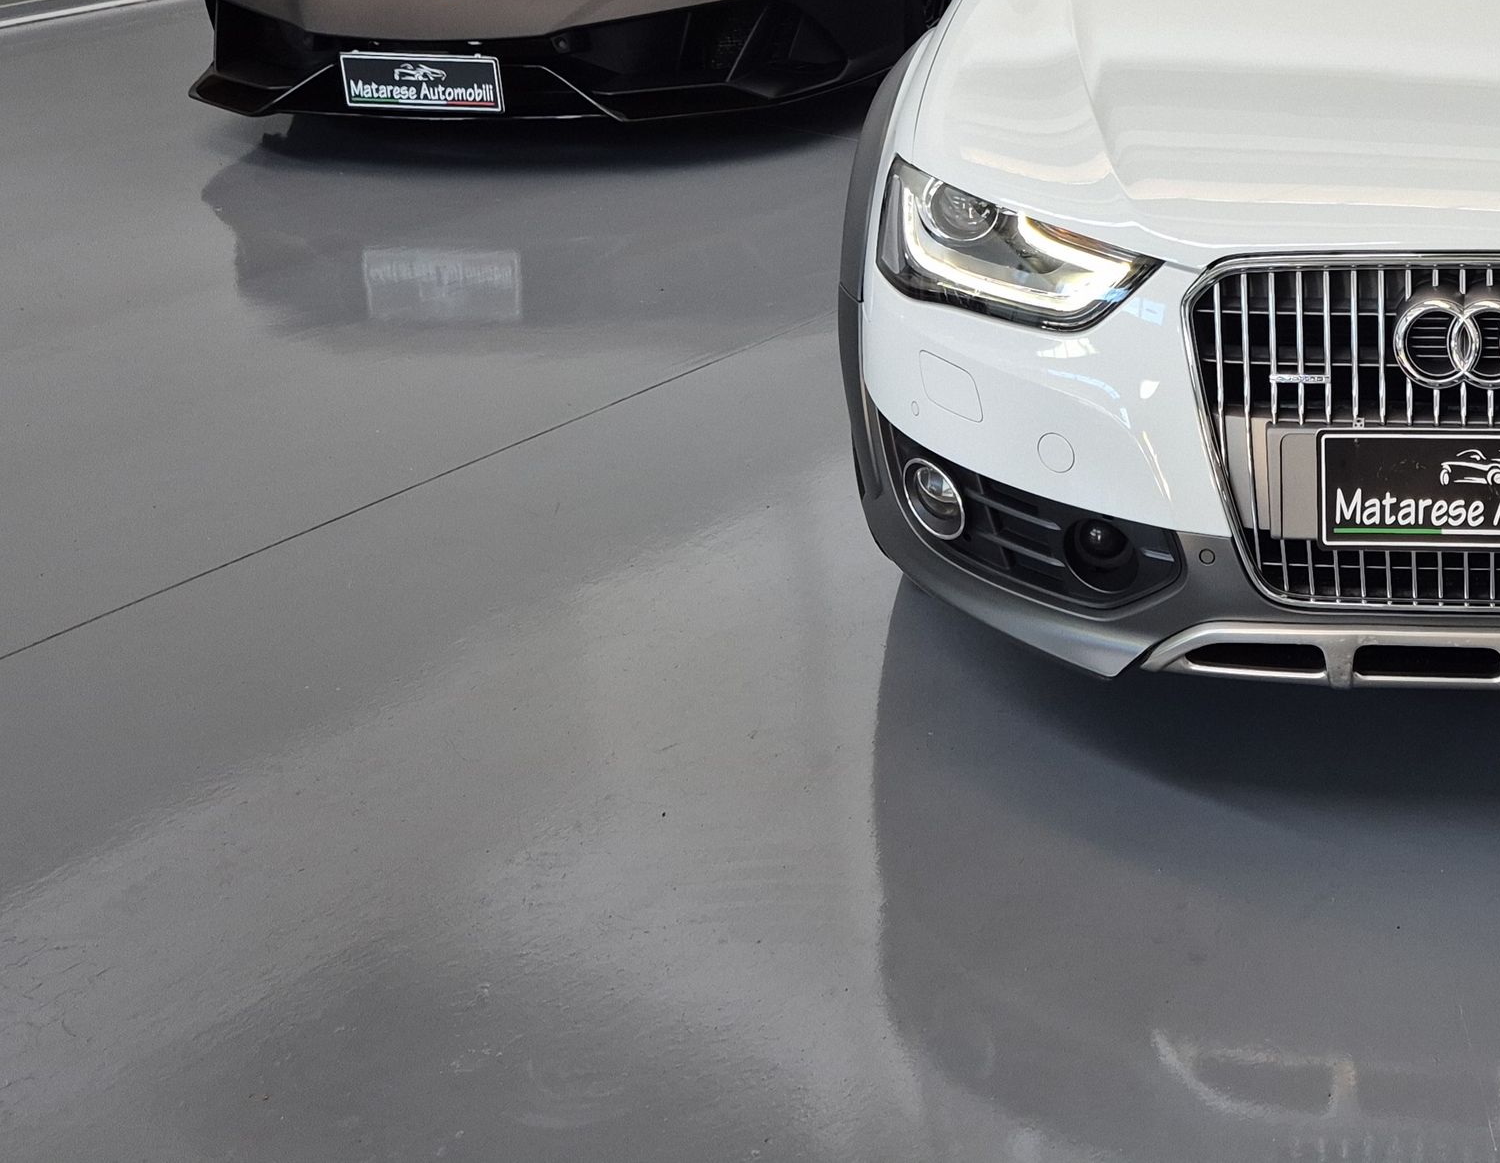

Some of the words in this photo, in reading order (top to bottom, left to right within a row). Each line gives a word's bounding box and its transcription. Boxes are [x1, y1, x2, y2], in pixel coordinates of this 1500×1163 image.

[350, 79, 417, 99] Matarese
[420, 82, 494, 102] Automobili
[1335, 487, 1485, 527] Matarese
